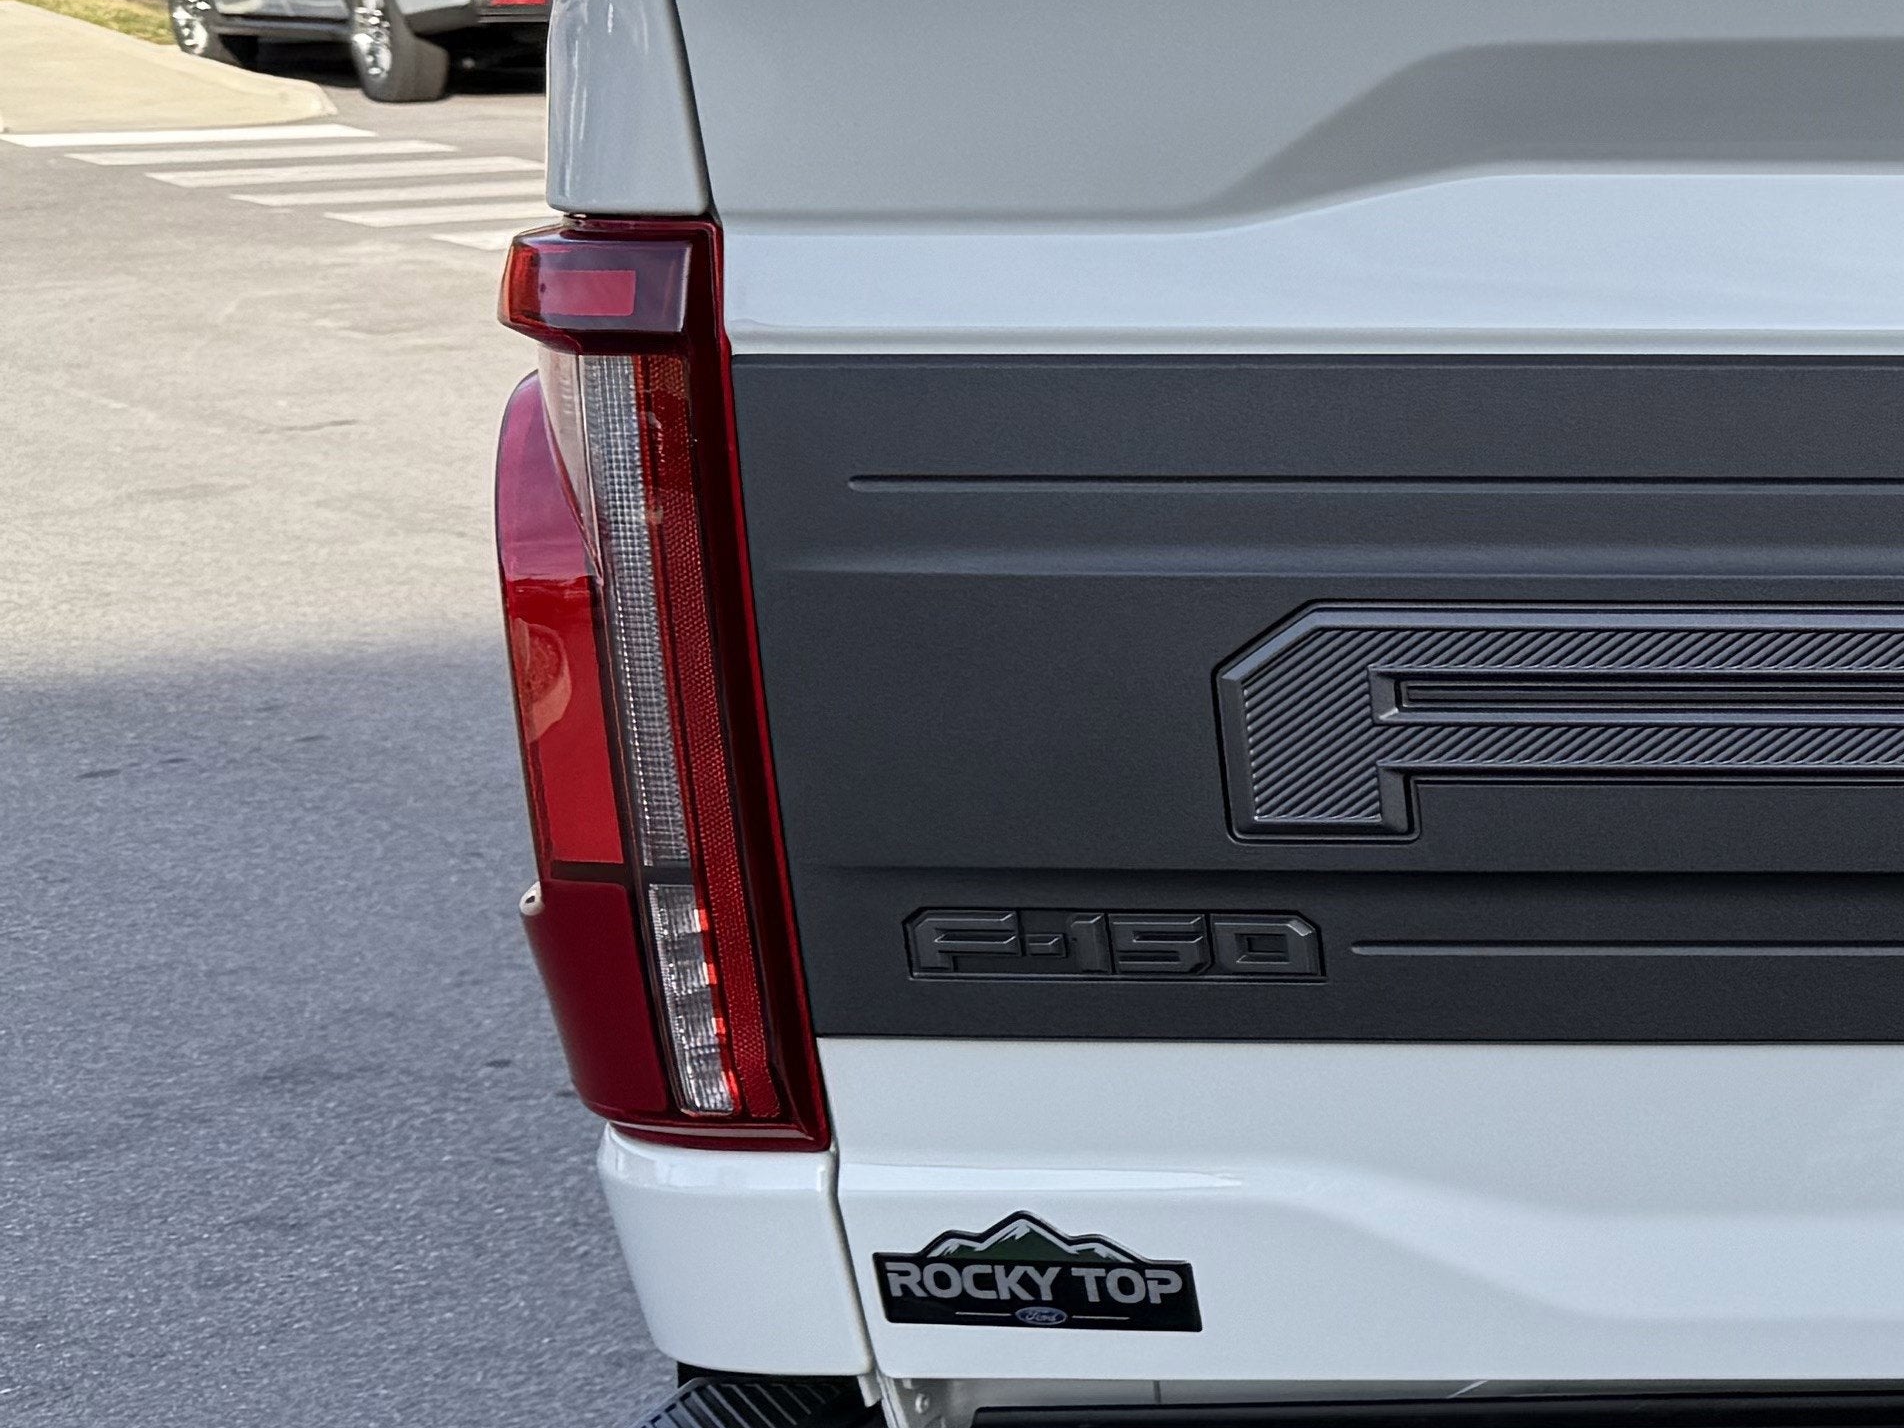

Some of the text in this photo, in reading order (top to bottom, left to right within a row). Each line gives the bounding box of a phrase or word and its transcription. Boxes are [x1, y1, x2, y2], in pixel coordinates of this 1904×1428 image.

[901, 906, 1327, 982] F-150
[885, 1261, 1183, 1304] ROCKY TOP
